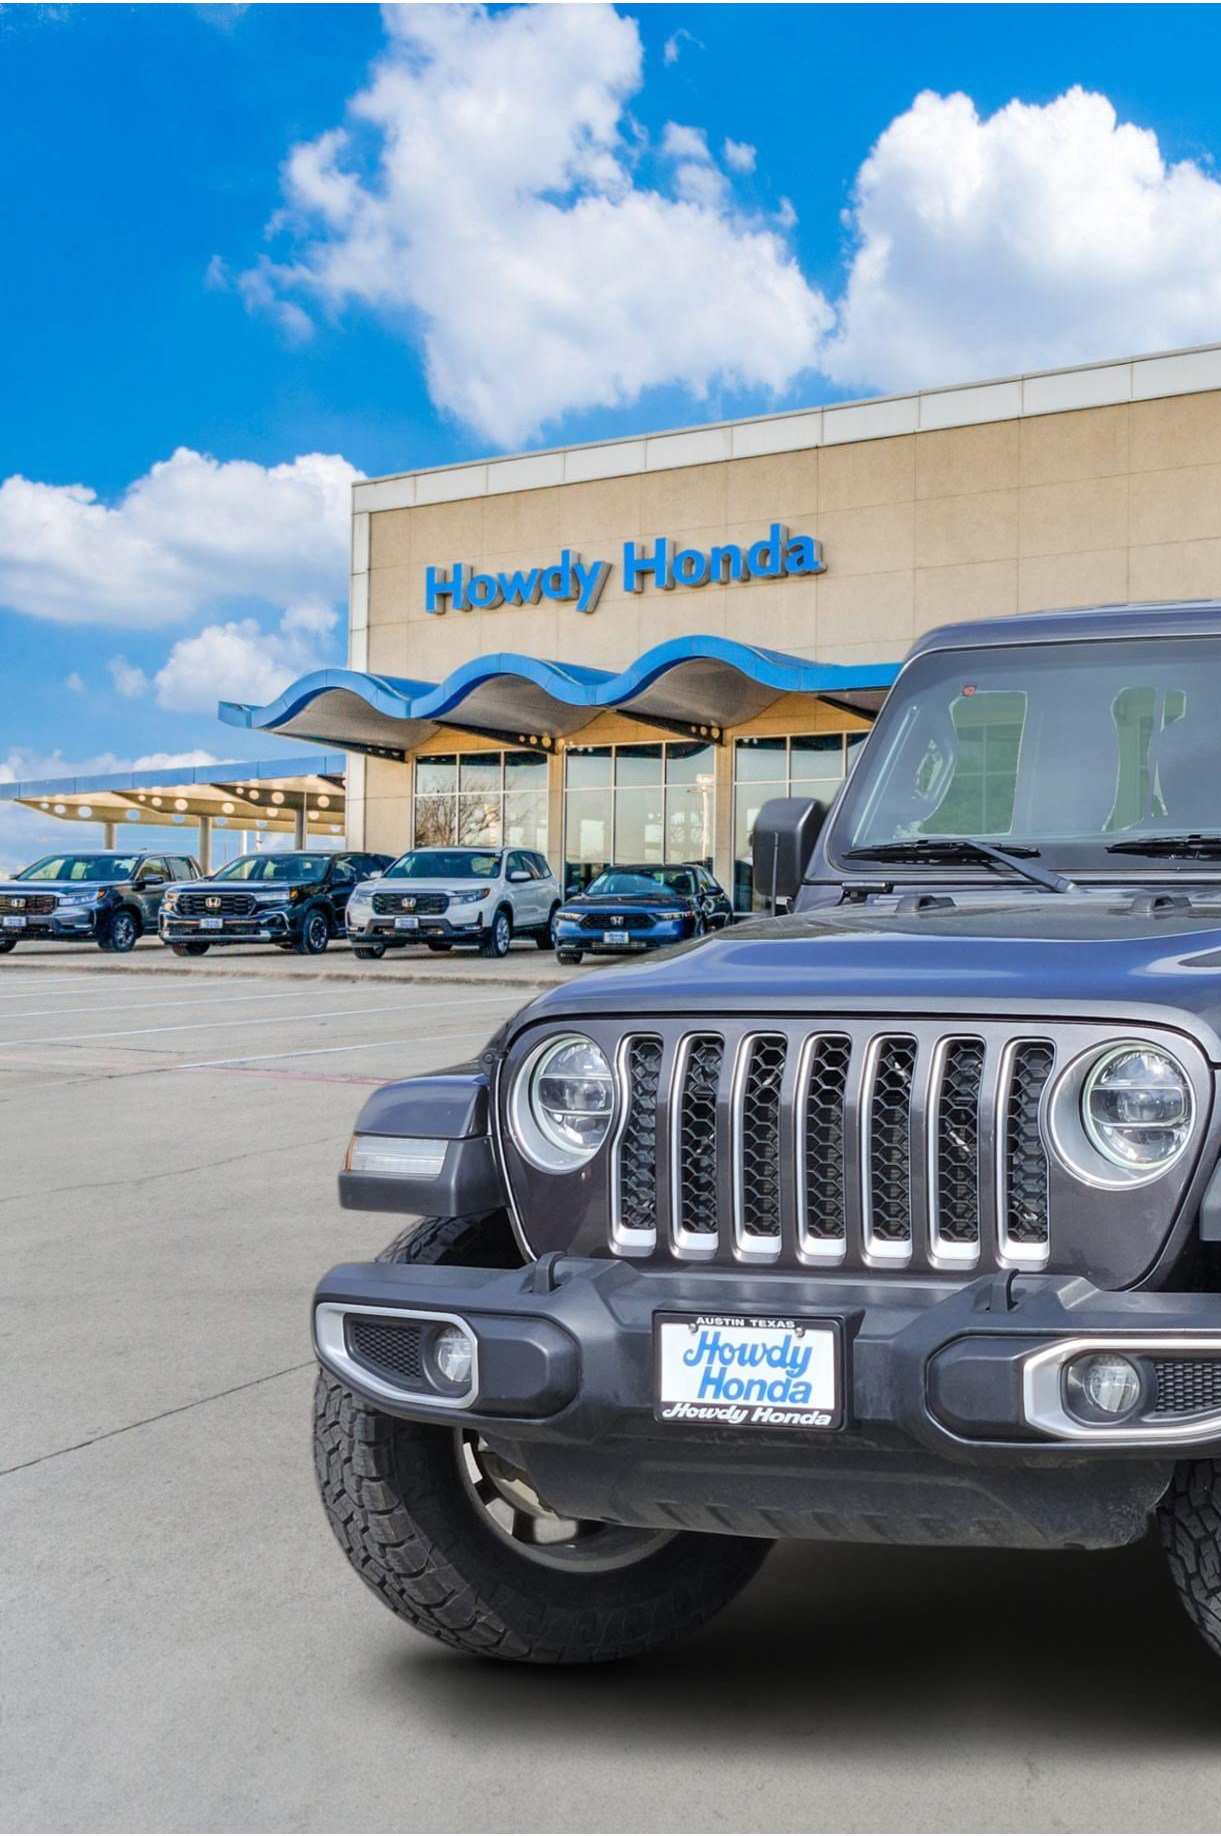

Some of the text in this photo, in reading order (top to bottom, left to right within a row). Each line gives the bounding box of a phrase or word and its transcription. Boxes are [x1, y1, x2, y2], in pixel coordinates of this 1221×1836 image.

[425, 523, 826, 614] Howdy Honda
[696, 1316, 796, 1329] AUSTIN TEXAS
[683, 1331, 812, 1378] Howdy
[697, 1366, 813, 1404] Honda
[662, 1402, 832, 1426] Howdy Honda
